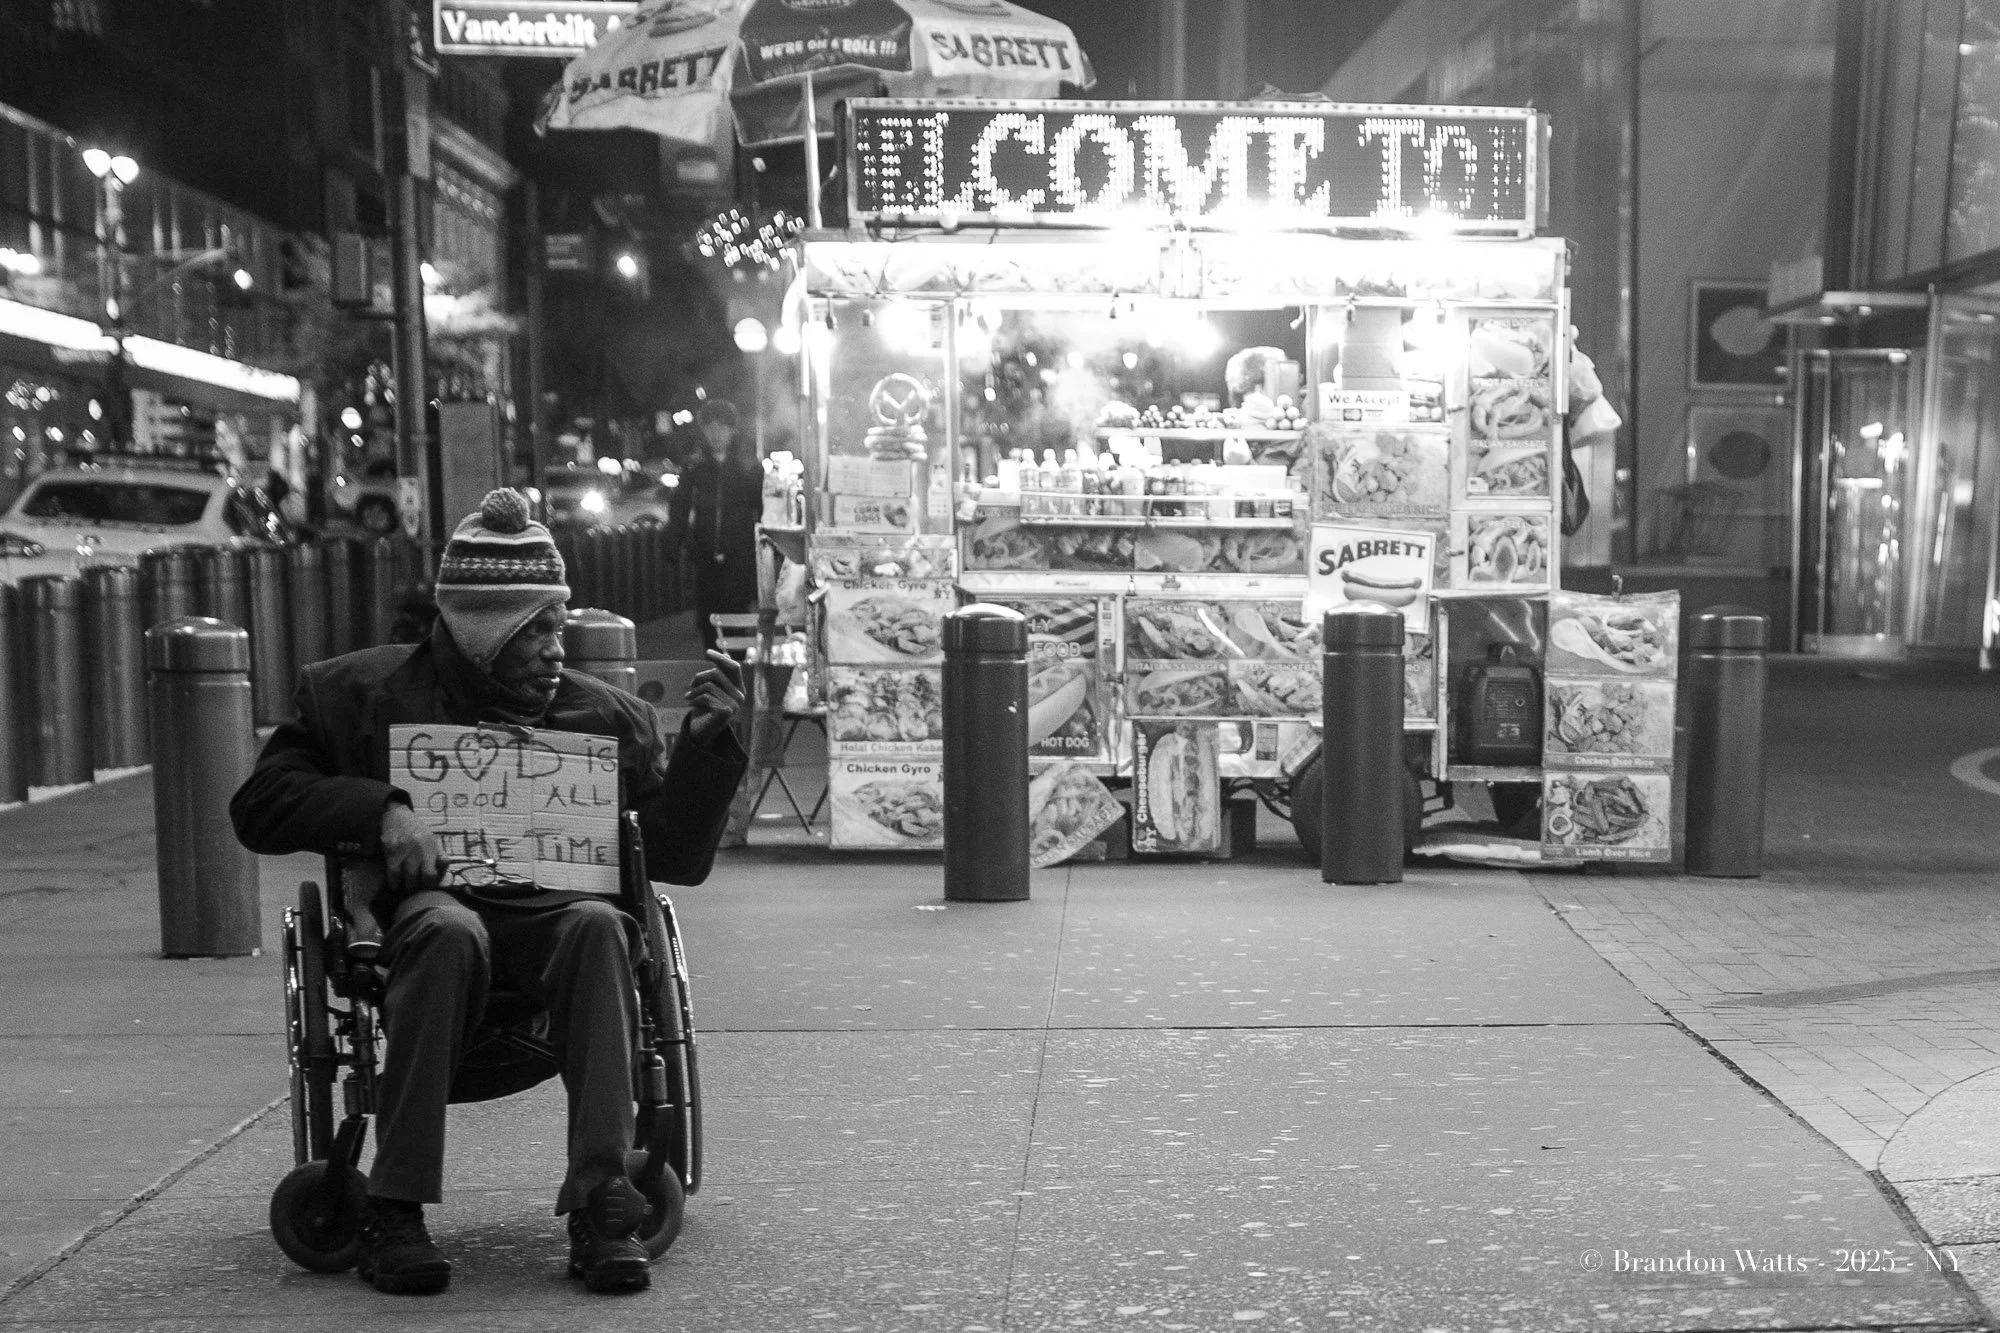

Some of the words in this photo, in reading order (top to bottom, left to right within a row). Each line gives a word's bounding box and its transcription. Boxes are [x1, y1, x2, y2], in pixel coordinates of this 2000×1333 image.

[441, 9, 598, 48] Vanderbilt
[807, 39, 828, 50] ON
[842, 38, 877, 56] ROLL
[930, 31, 1071, 71] SABRETT
[1328, 394, 1352, 404] We
[1318, 540, 1426, 576] SABRETT
[843, 580, 893, 591] Chicken
[898, 580, 928, 593] Gyro
[1033, 642, 1082, 658] FOOD
[871, 742, 913, 753] Chicken
[916, 742, 944, 753] Keba
[1041, 737, 1063, 748] HOT
[1065, 737, 1090, 749] DOG
[846, 763, 898, 774] Chicken
[901, 763, 931, 776] Gyro
[1574, 756, 1610, 767] Chicken
[1136, 731, 1149, 823] Cheeseburger
[427, 771, 508, 827] good
[545, 784, 612, 808] ALL
[432, 829, 516, 861] THE
[1575, 847, 1602, 857] Lamb
[1603, 848, 1626, 858] Over
[1628, 848, 1651, 858] Rice
